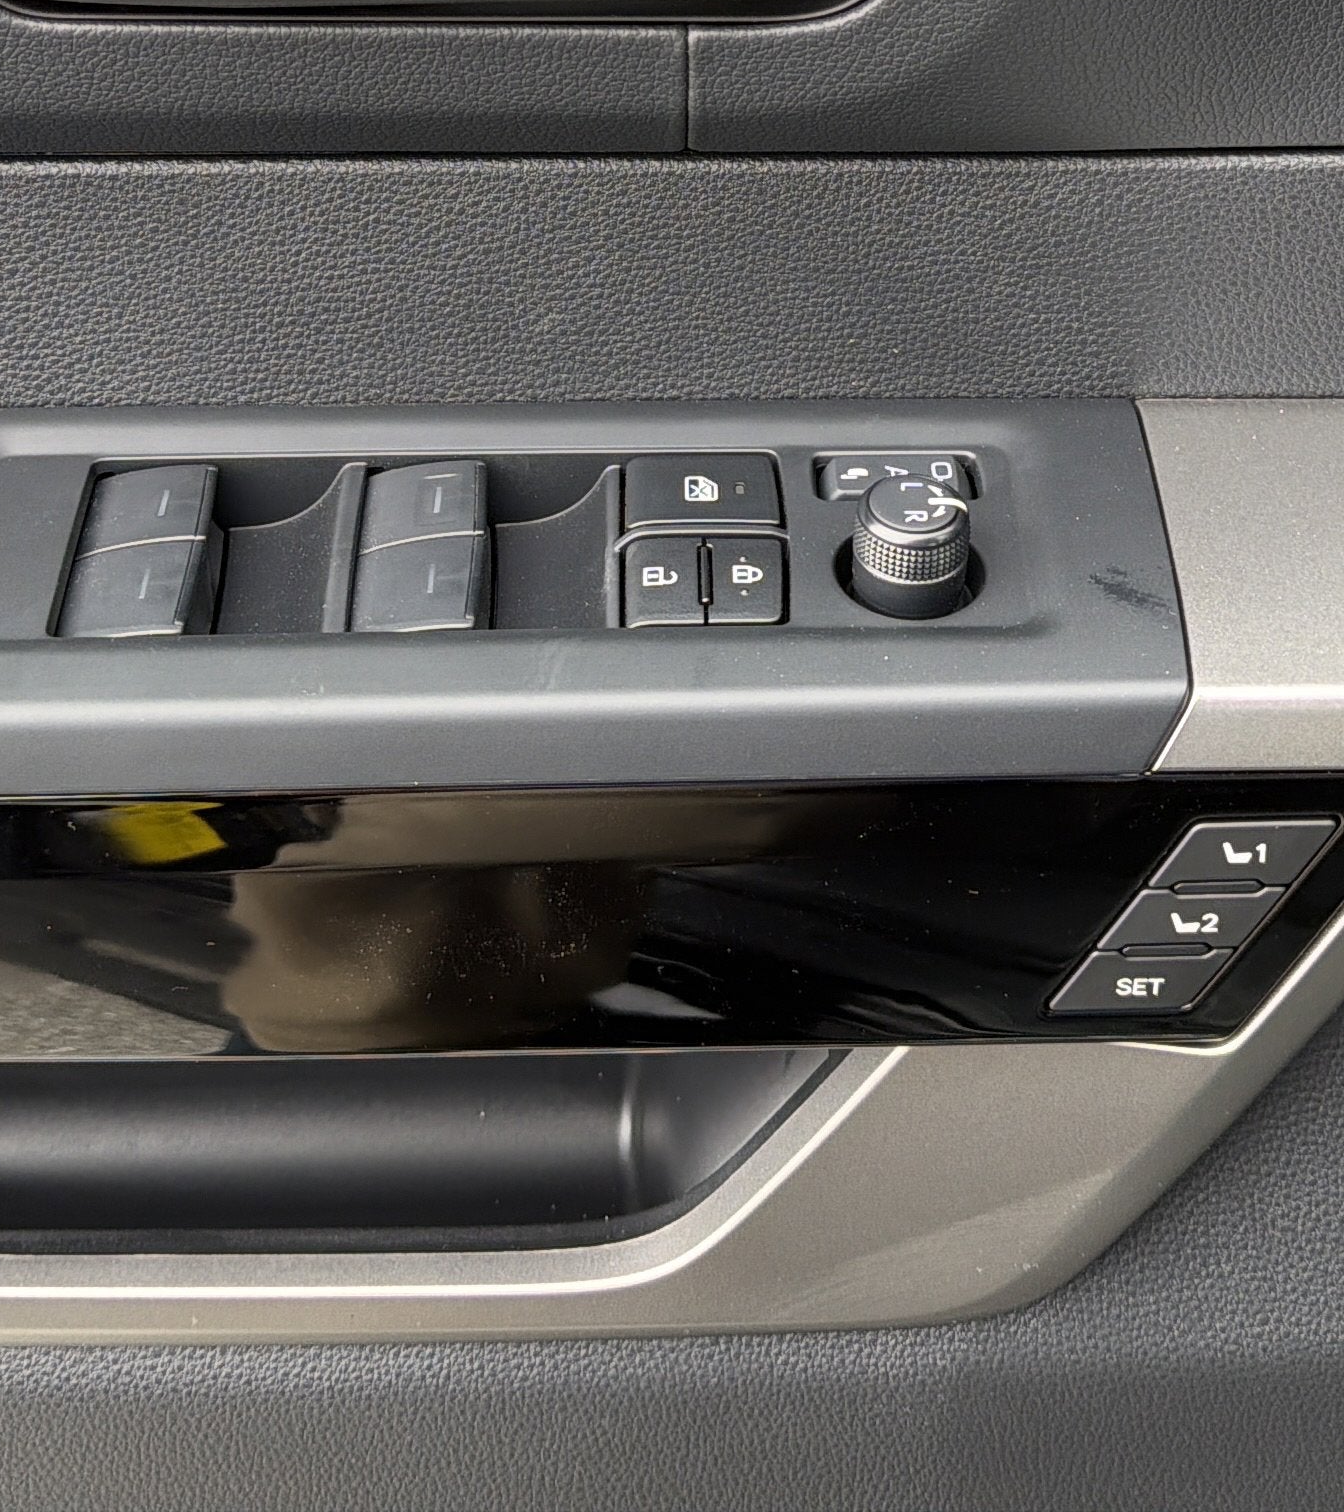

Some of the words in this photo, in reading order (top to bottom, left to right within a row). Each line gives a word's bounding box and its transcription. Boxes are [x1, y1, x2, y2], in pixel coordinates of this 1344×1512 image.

[900, 482, 924, 492] L
[903, 510, 929, 523] R
[1255, 843, 1267, 864] 1
[1201, 913, 1219, 933] 2
[1115, 977, 1165, 997] SET
